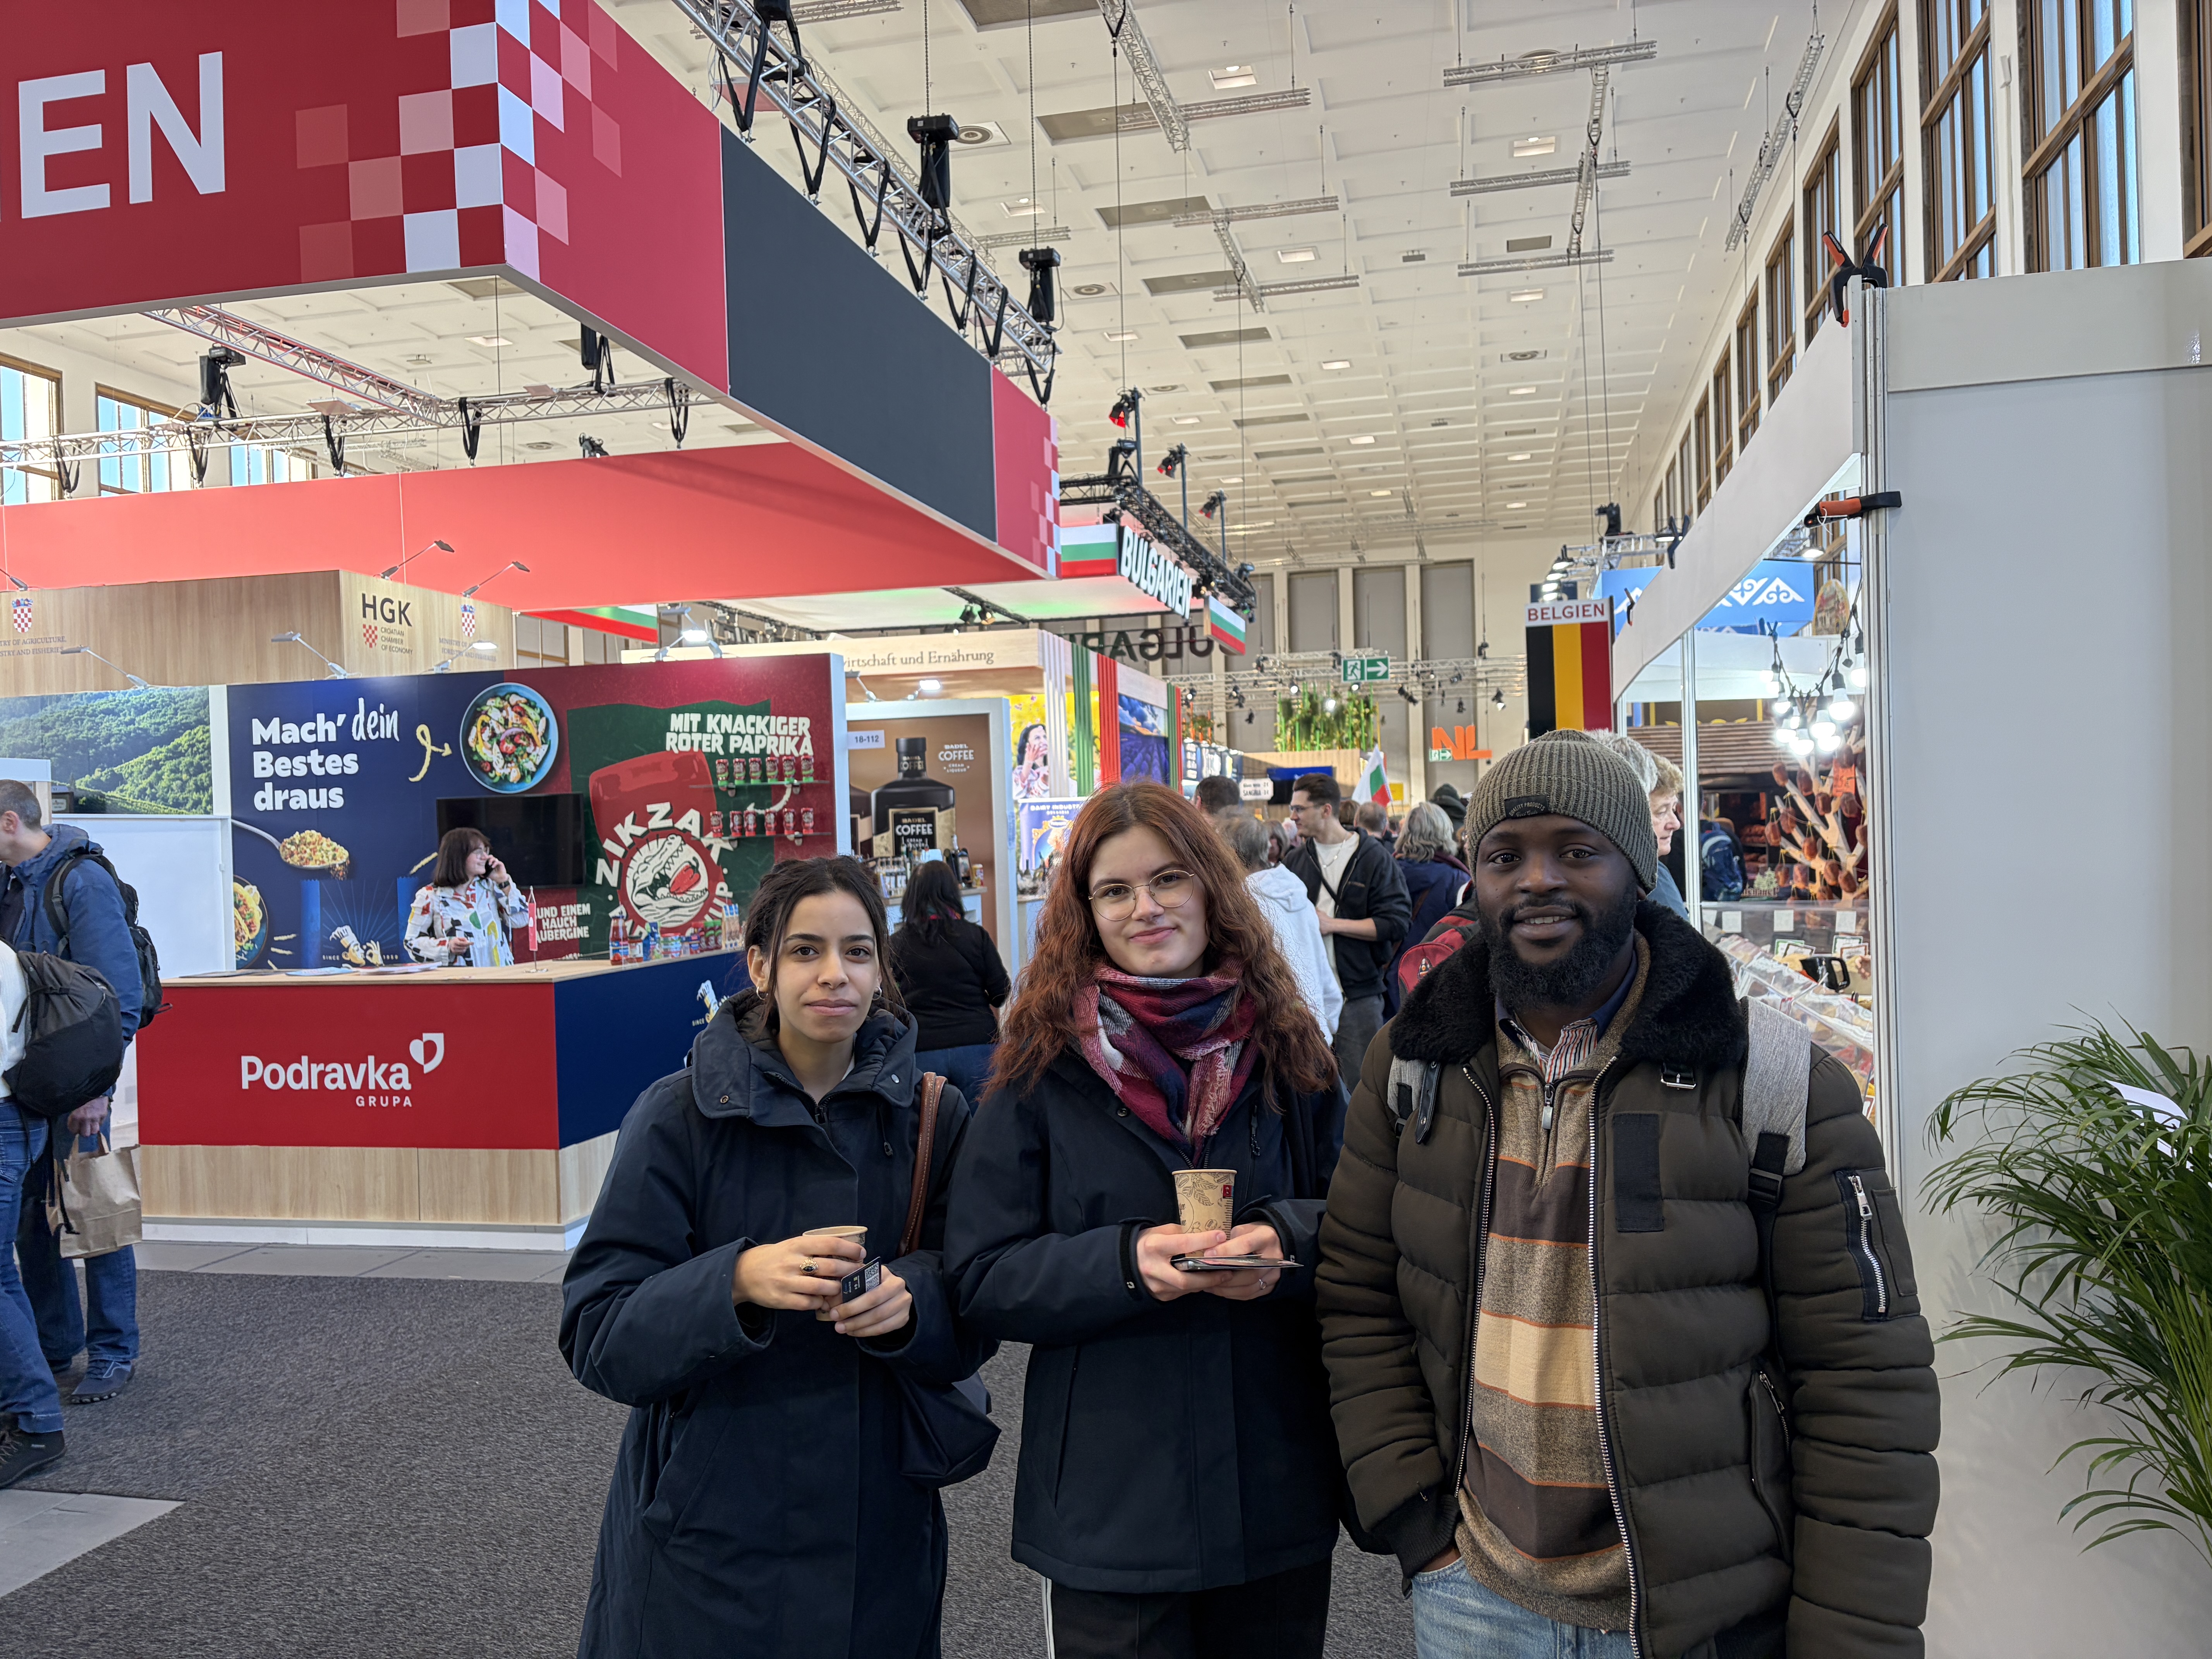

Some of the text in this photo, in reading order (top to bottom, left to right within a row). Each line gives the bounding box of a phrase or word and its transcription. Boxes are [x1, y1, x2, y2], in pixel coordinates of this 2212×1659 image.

[0, 51, 226, 222] EN
[1120, 526, 1193, 620] BULGARIEN
[362, 593, 412, 627] HGK
[1528, 603, 1604, 622] BELGIEN
[381, 627, 404, 636] CROATIAN
[381, 636, 404, 646] CHAMBER
[389, 646, 413, 655] ECONOMY
[900, 651, 924, 665] und
[928, 649, 994, 665] Ernährung
[352, 697, 400, 742] dein
[670, 713, 811, 738] MIT KNACKIGER
[666, 732, 814, 757] ROTER PAPRIKA
[1432, 725, 1492, 761] NL
[253, 749, 359, 778] Bestes
[938, 750, 974, 761] COFFEE
[254, 782, 344, 811] draus
[1509, 803, 1523, 817] QUALITY
[1524, 802, 1546, 812] PRODUCTS
[896, 823, 933, 836] COFFEE
[537, 903, 591, 919] UND EINEM
[542, 916, 577, 929] HAUCH
[241, 1055, 411, 1090] Podravka
[356, 1096, 412, 1108] GRUPA
